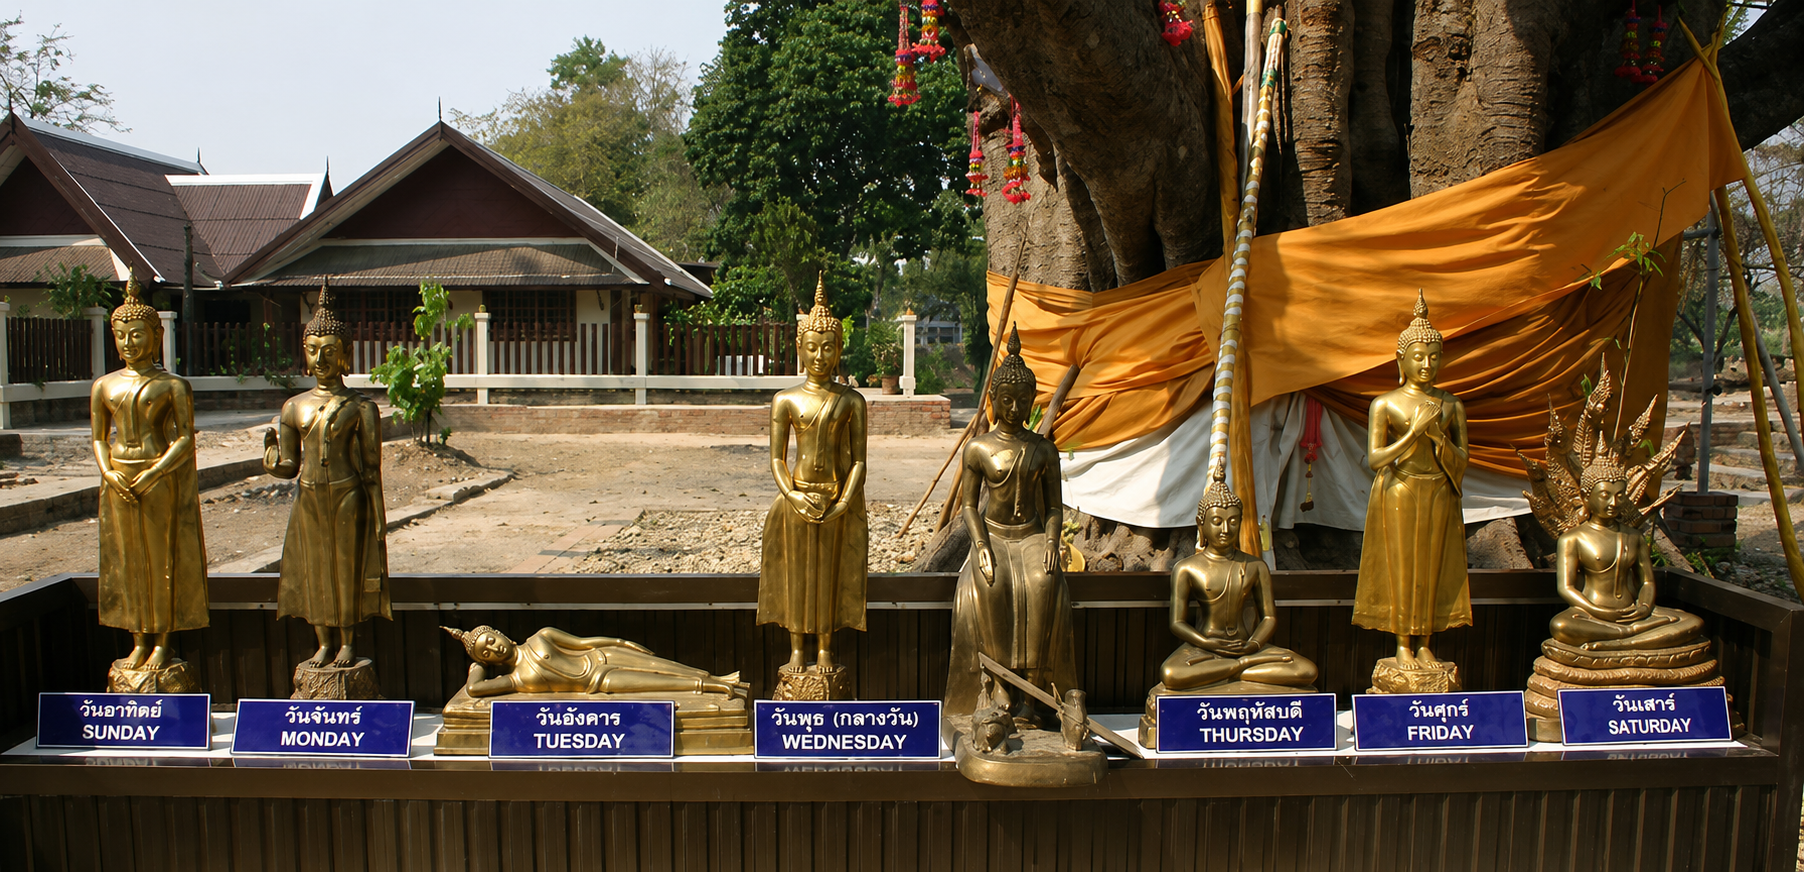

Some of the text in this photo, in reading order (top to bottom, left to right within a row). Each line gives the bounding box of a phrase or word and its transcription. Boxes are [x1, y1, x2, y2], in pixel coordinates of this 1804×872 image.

[1409, 699, 1469, 722] วันศุกร์
[1613, 693, 1676, 712] วันเสาร์
[284, 706, 362, 724] วันจันทร์
[536, 707, 620, 725] วันอังคาร
[771, 707, 919, 732] วันพุธ (กลางวัน)
[82, 725, 160, 740] SUNDAY
[1408, 725, 1474, 740] FRIDAY
[1608, 718, 1691, 734] SATURDAY
[281, 731, 365, 747] MONDAY
[534, 734, 625, 748] TUESDAY
[782, 735, 907, 749] WEDNESDAY
[1200, 727, 1304, 742] THURSDAY
